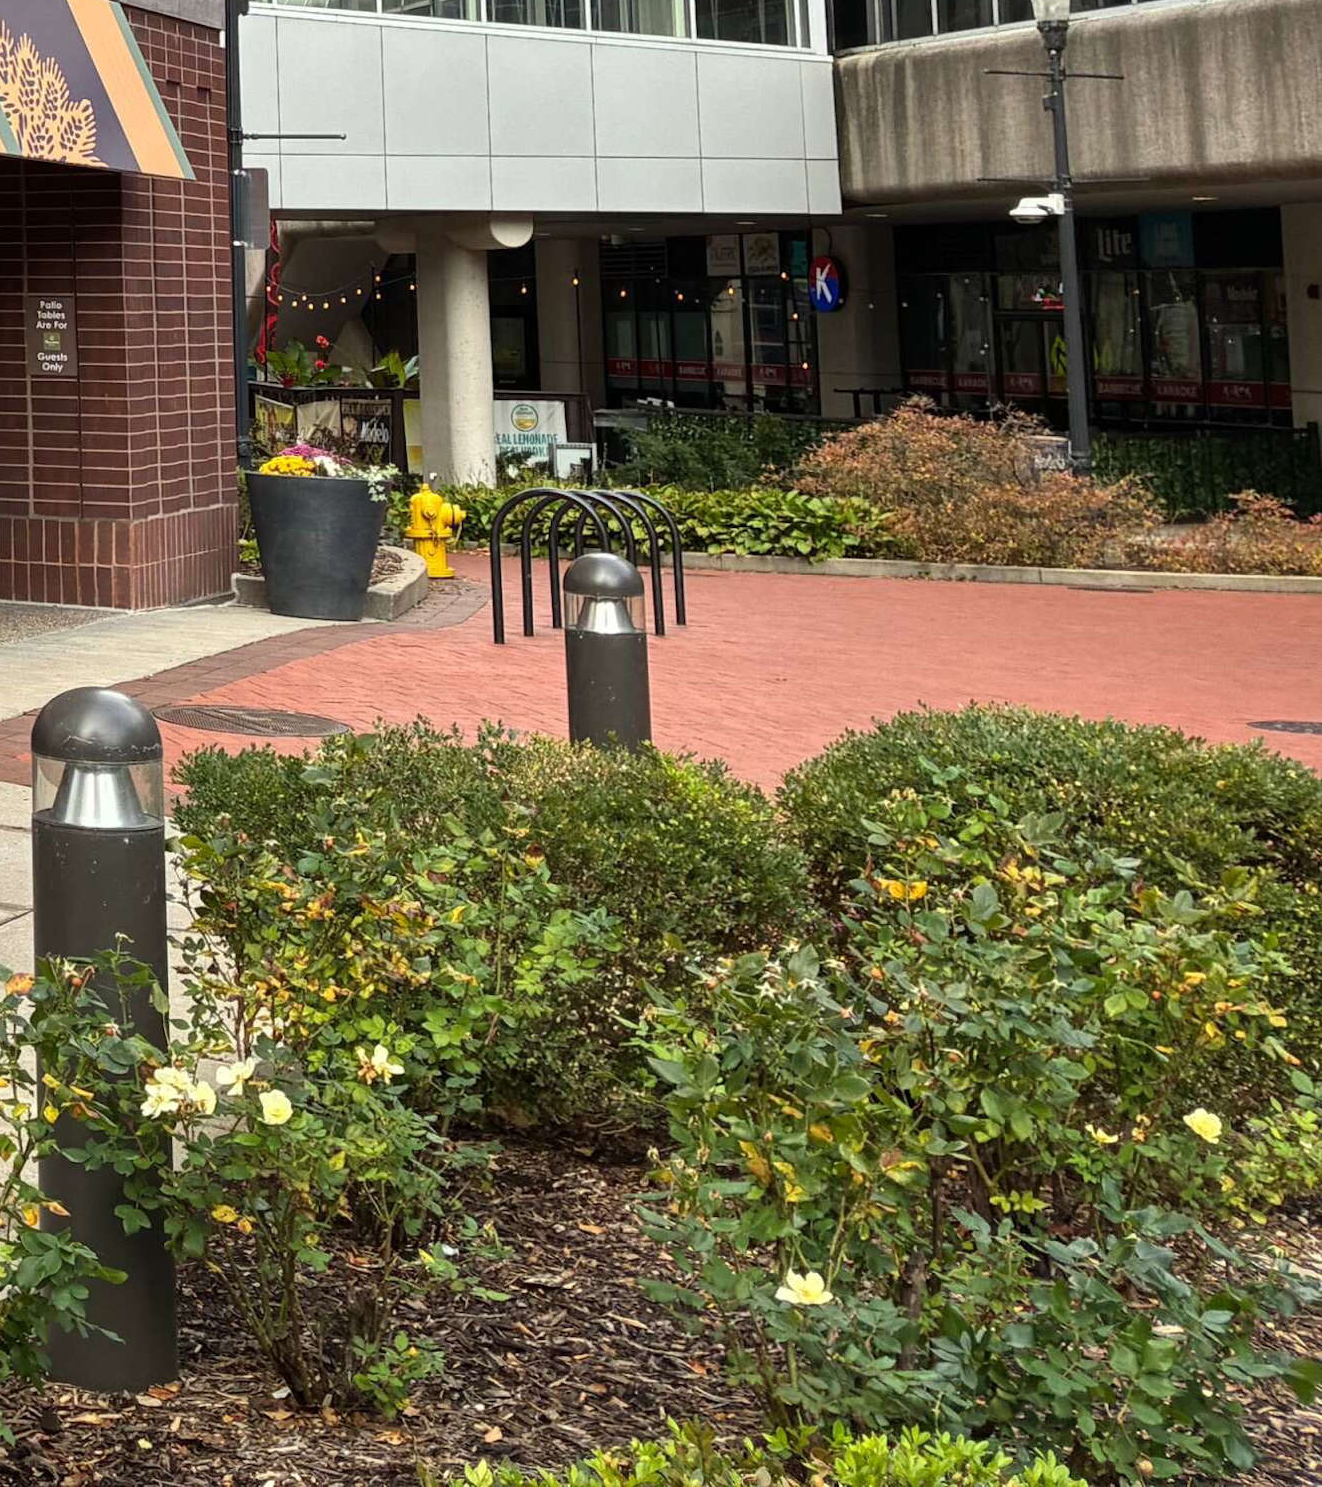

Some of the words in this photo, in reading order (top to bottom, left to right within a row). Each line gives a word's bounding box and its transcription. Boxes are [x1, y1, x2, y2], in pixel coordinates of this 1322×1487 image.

[816, 263, 833, 304] K
[37, 311, 65, 319] Tables
[36, 321, 51, 329] Are
[54, 321, 68, 329] For
[37, 352, 68, 362] Guests
[42, 363, 63, 373] Only
[360, 420, 390, 444] Modelo
[495, 433, 512, 445] EAL
